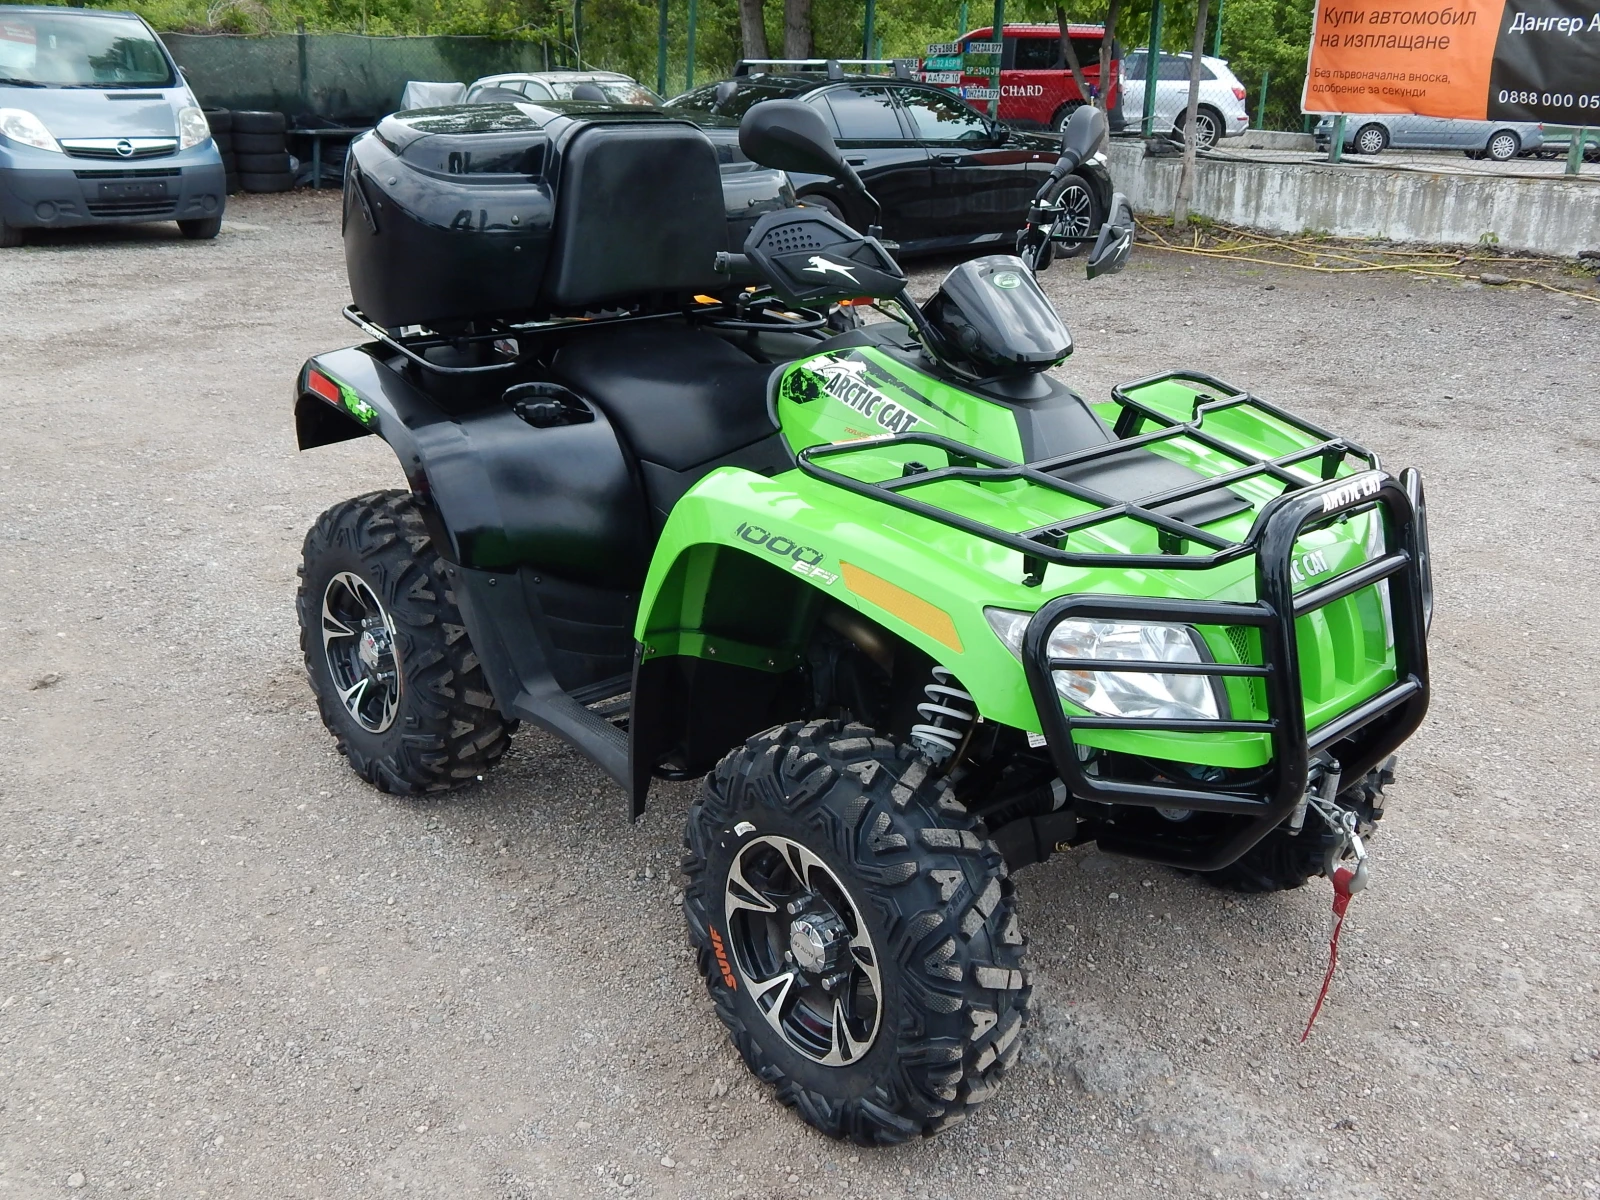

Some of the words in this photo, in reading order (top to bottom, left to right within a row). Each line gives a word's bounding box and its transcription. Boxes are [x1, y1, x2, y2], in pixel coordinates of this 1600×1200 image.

[1324, 7, 1365, 28] Купи
[1368, 7, 1477, 26] автомобил
[1508, 12, 1583, 36] Дангер
[929, 44, 938, 54] FS
[1320, 33, 1340, 48] на
[1344, 34, 1450, 51] изплащане
[1314, 68, 1331, 78] Без
[1333, 69, 1406, 81] първоначална
[1409, 73, 1451, 84] вноска,
[1000, 85, 1043, 97] CHARD
[1312, 83, 1366, 94] одобрение
[1368, 86, 1380, 94] за
[1382, 86, 1426, 98] секунди
[1498, 89, 1538, 105] 0888
[1542, 93, 1573, 107] 000
[1578, 94, 1600, 109] 05
[824, 373, 882, 417] ARCTIC
[878, 403, 918, 432] CAT
[1321, 480, 1361, 513] ARCTIC
[1361, 475, 1381, 496] CAT
[735, 521, 824, 566] 1000
[1302, 550, 1329, 577] CAT
[709, 924, 737, 991] SUNF
